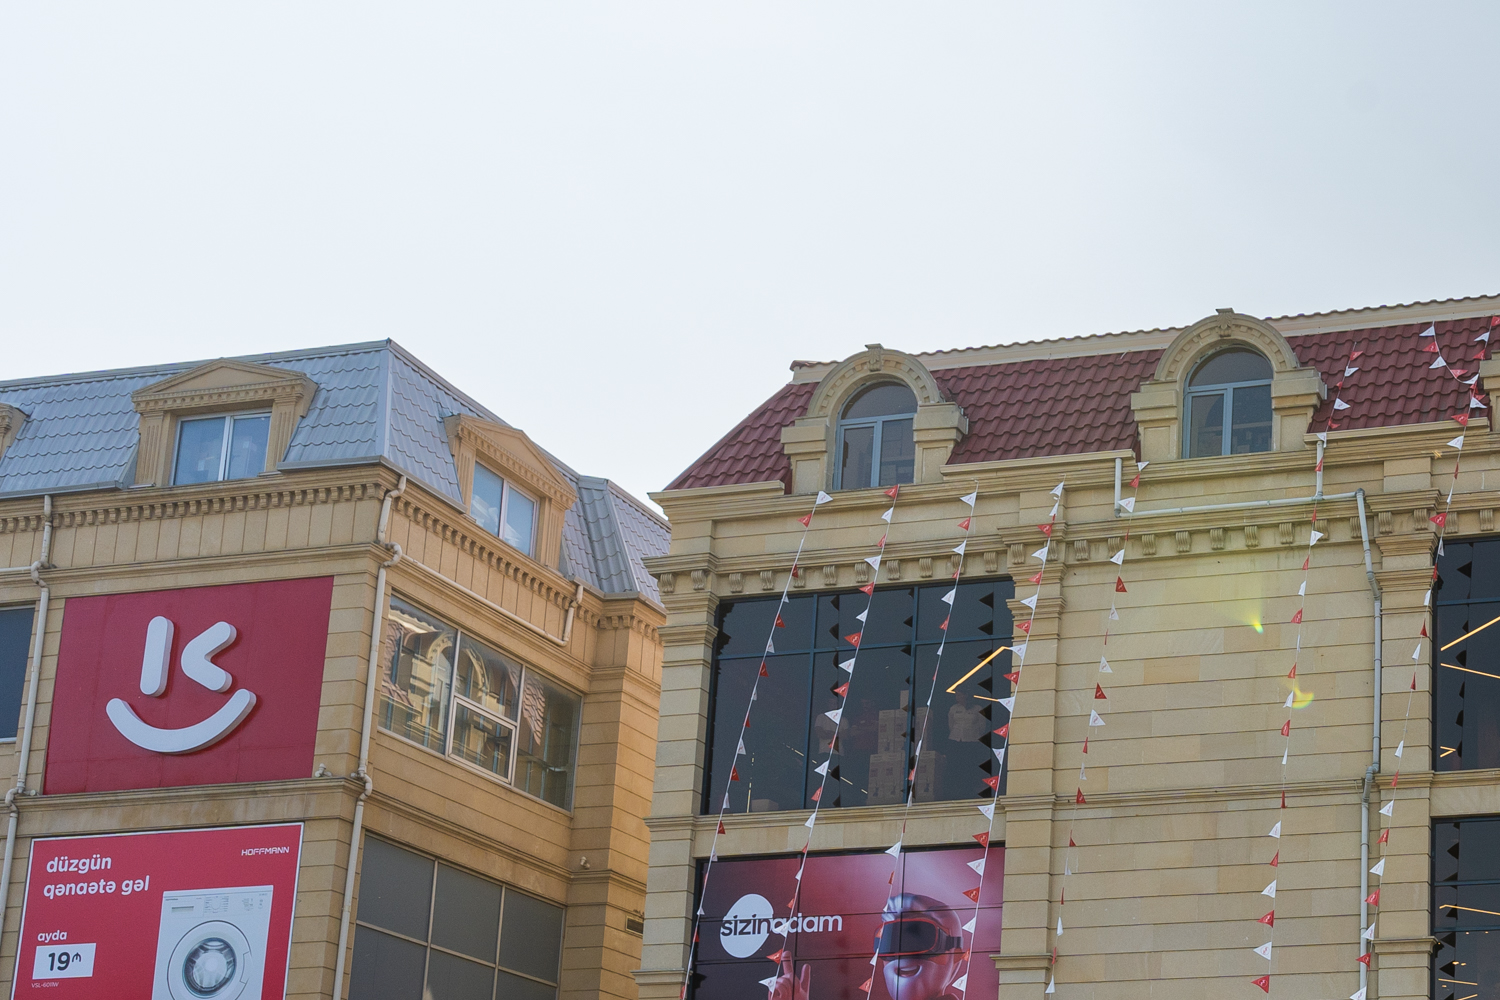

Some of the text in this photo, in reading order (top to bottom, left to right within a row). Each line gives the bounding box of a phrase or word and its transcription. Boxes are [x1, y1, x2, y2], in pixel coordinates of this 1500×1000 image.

[241, 846, 290, 856] HOFFMANN
[46, 854, 112, 874] düzgün
[43, 875, 150, 899] qənaətə gəl
[720, 912, 843, 936] sizinadam
[37, 930, 68, 942] ayda
